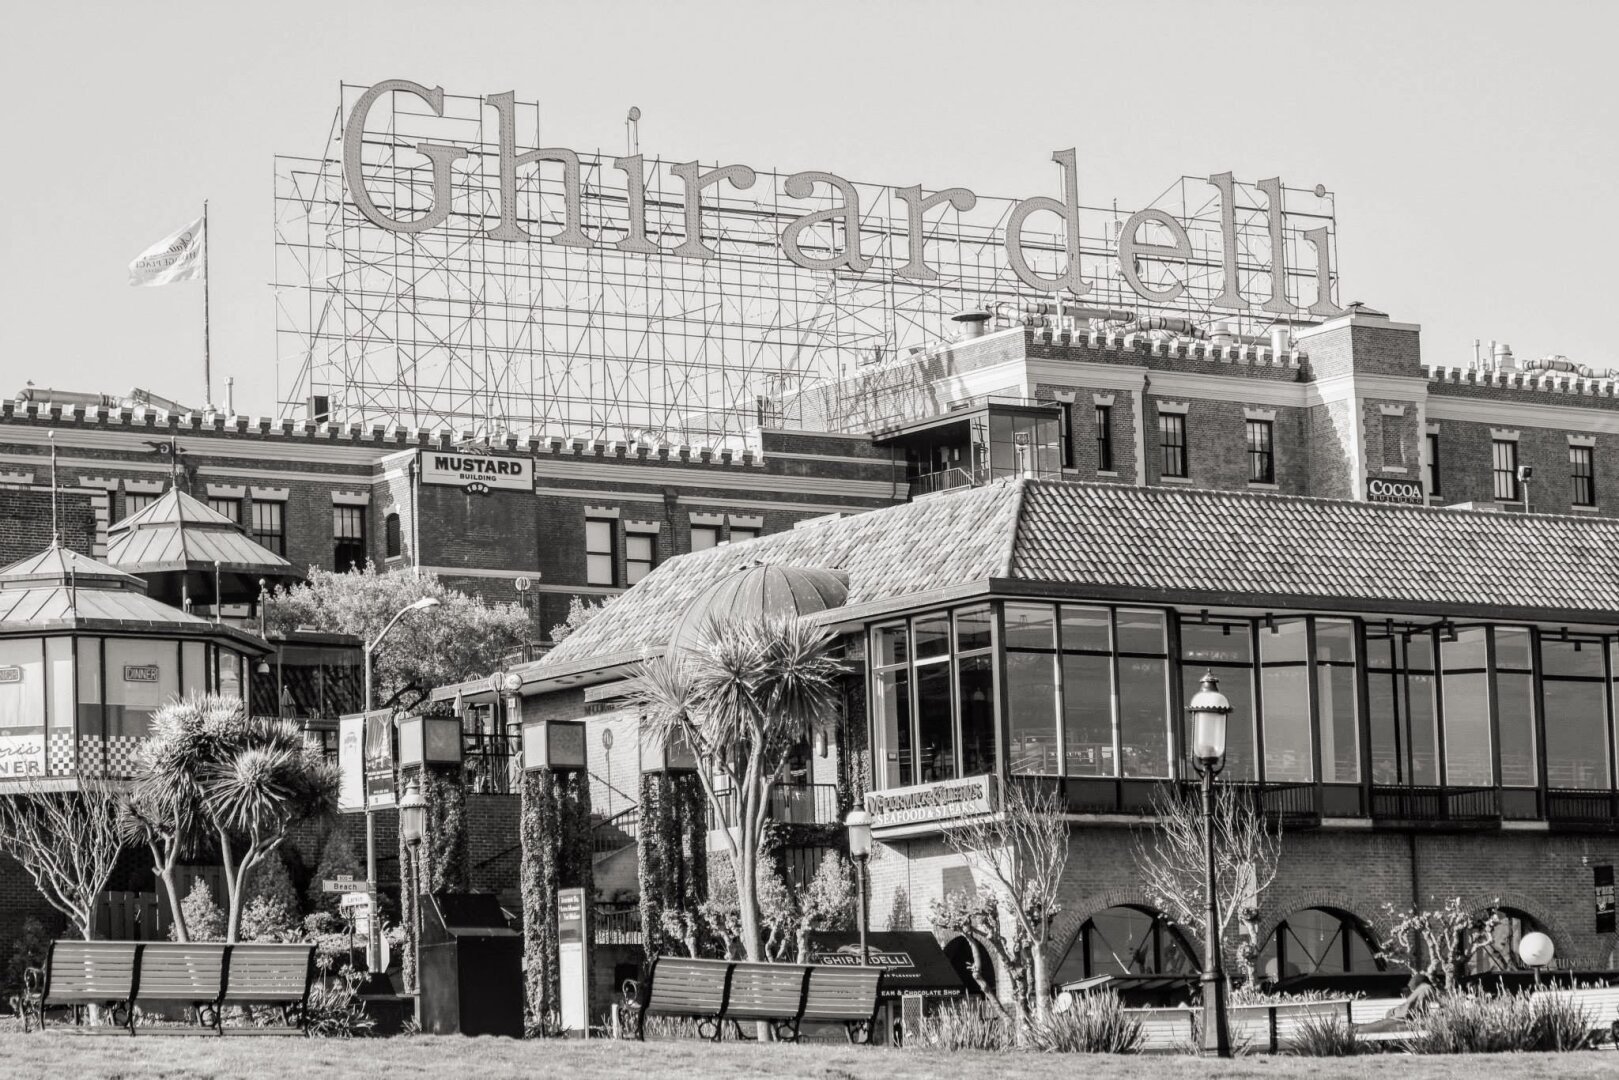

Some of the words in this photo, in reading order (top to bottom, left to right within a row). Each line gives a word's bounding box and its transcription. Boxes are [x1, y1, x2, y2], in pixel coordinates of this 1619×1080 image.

[342, 79, 1342, 317] Ghirardelli
[435, 456, 523, 475] MUSTARD
[459, 473, 497, 481] BUILDING
[1370, 480, 1422, 498] COCOA
[127, 668, 157, 679] DINNER
[878, 807, 926, 825] SEAFOOD
[928, 808, 934, 819] &
[936, 800, 976, 817] STEAKS
[823, 956, 909, 965] GHIRADELLI
